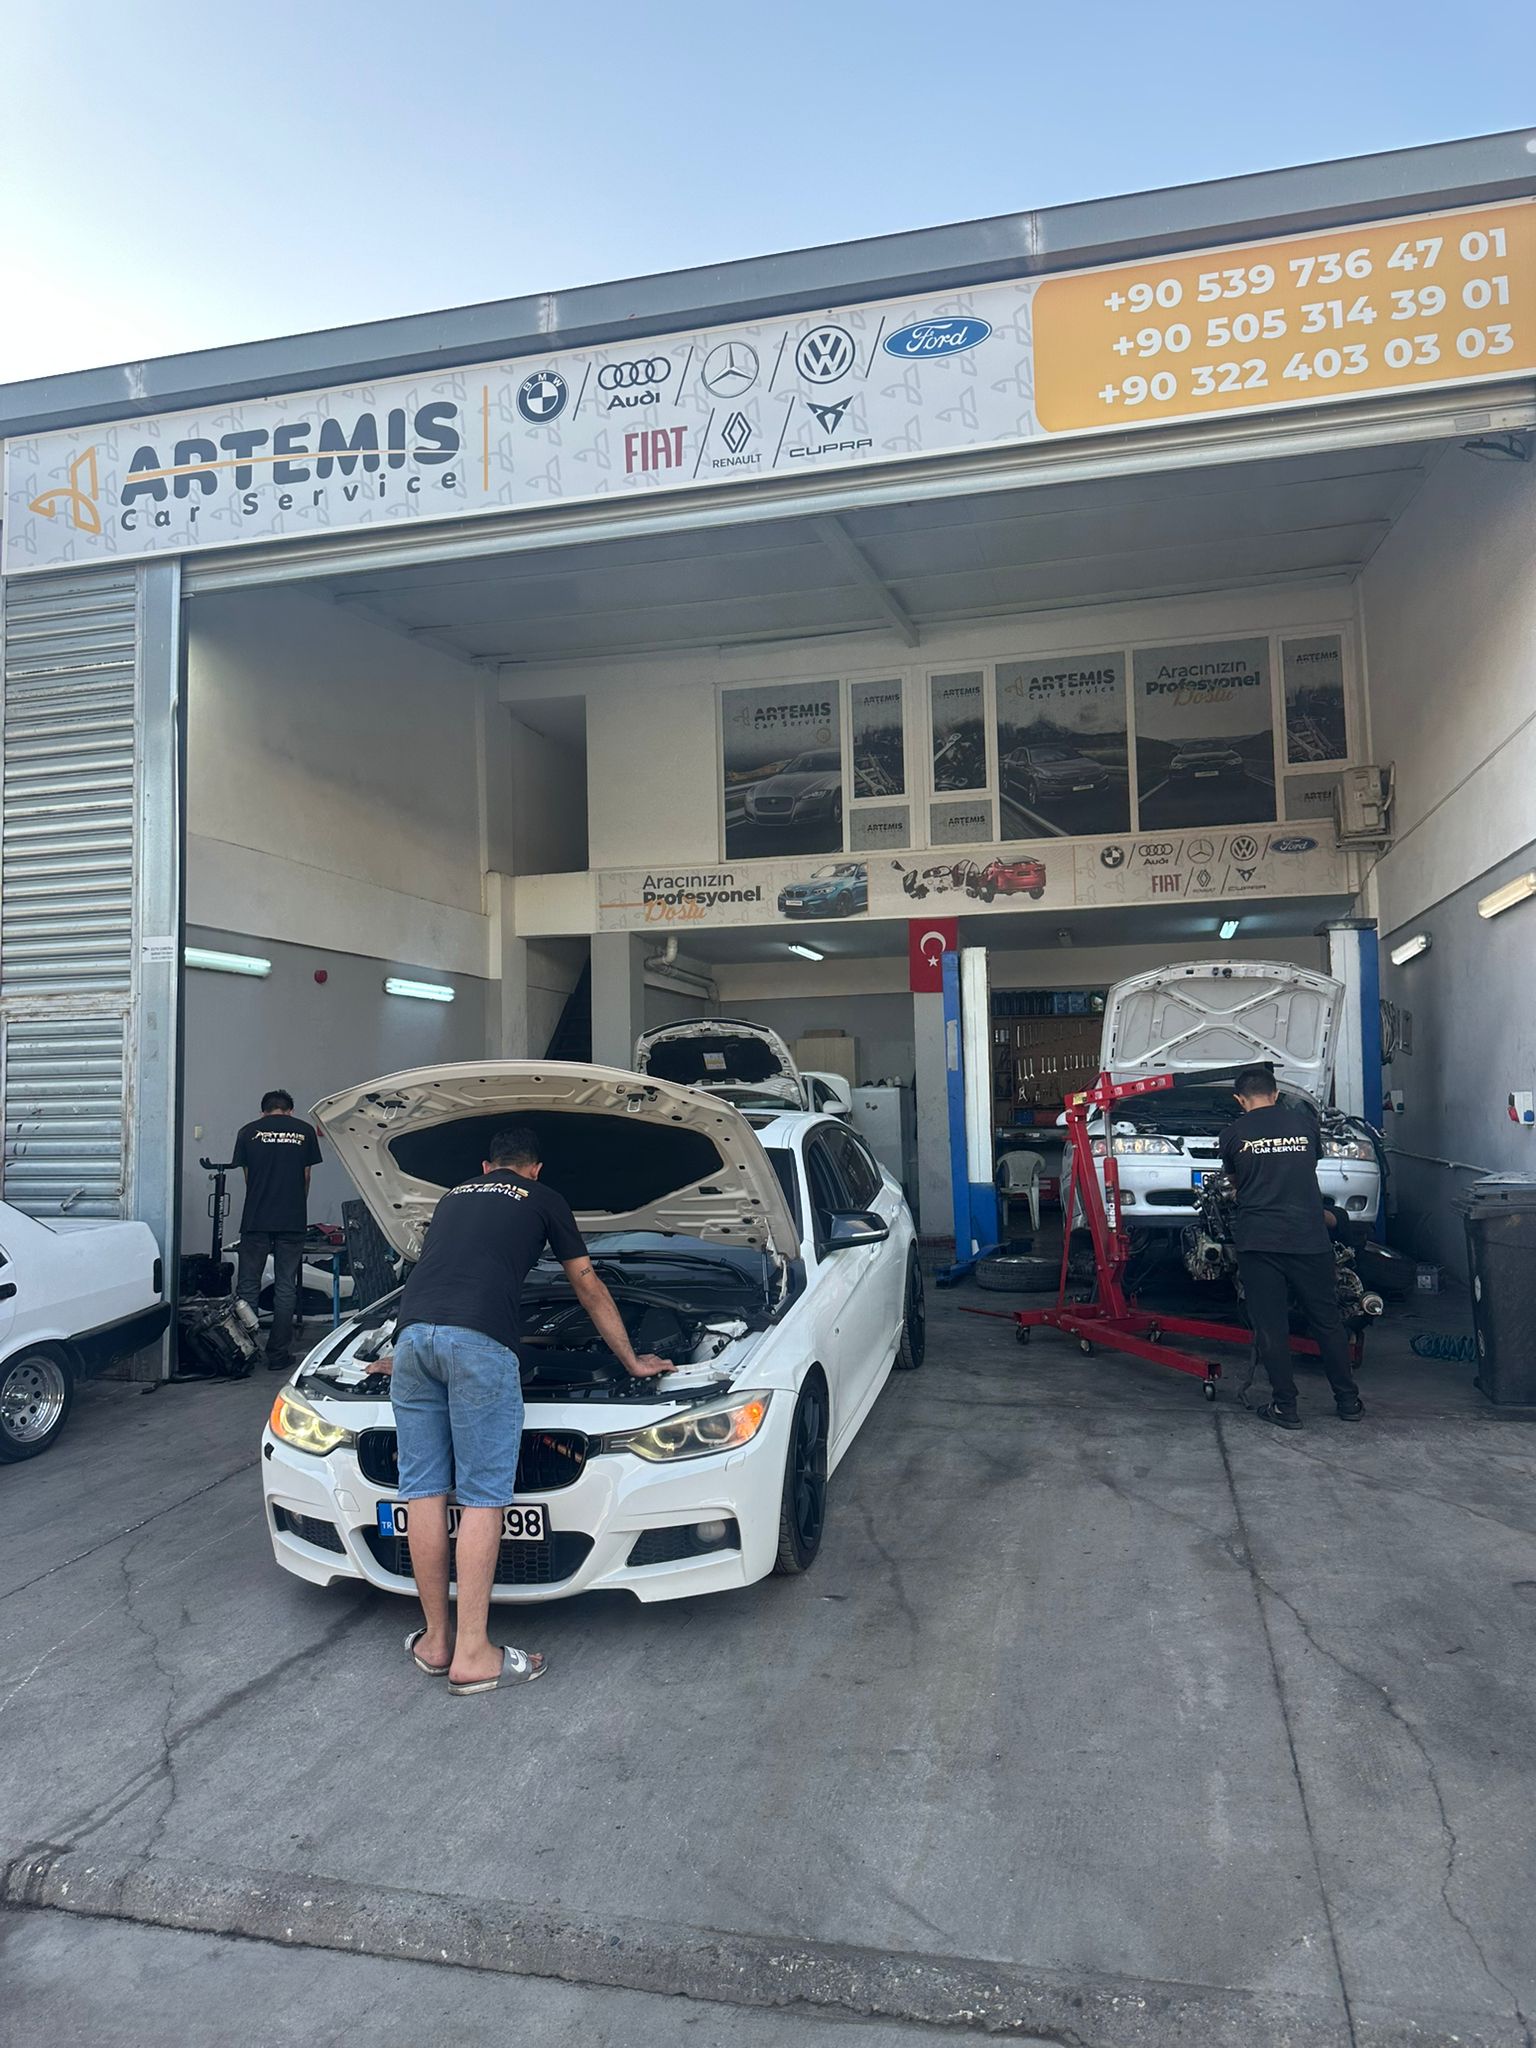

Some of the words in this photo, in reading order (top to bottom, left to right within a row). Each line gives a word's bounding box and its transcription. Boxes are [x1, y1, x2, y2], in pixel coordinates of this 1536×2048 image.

[1104, 278, 1183, 314] +90
[1197, 264, 1275, 303] 539
[1289, 248, 1373, 288] 736
[1387, 237, 1444, 272] 47
[1459, 227, 1508, 263] 01
[1112, 323, 1192, 358] +90
[1206, 309, 1288, 348] 505
[1300, 295, 1378, 334] 314
[1390, 285, 1447, 321] 39
[1462, 275, 1510, 310] 01
[906, 323, 968, 352] Ford
[1098, 371, 1178, 406] +90
[1191, 358, 1269, 397] 322
[1282, 344, 1369, 381] 403
[1383, 333, 1441, 370] 03
[1456, 323, 1515, 360] 03
[606, 392, 661, 411] Audi
[120, 401, 461, 507] ARTEMIS
[624, 425, 689, 475] FIAT
[789, 438, 873, 458] CUPRA
[712, 453, 762, 469] RENAULT
[121, 505, 201, 531] Car
[242, 468, 457, 516] Service
[1028, 668, 1116, 693] ARTEMIS
[1145, 671, 1261, 695] Profesyonel
[1060, 685, 1115, 698] Service
[754, 702, 831, 722] ARTEMIS
[1279, 838, 1309, 851] Ford
[1143, 857, 1169, 866] Audi
[1151, 873, 1182, 893] FIAT
[643, 885, 761, 907] Profesyonel
[1240, 1136, 1309, 1152] ARTEMIS
[1254, 1146, 1271, 1154] CAR
[381, 1521, 393, 1529] TR
